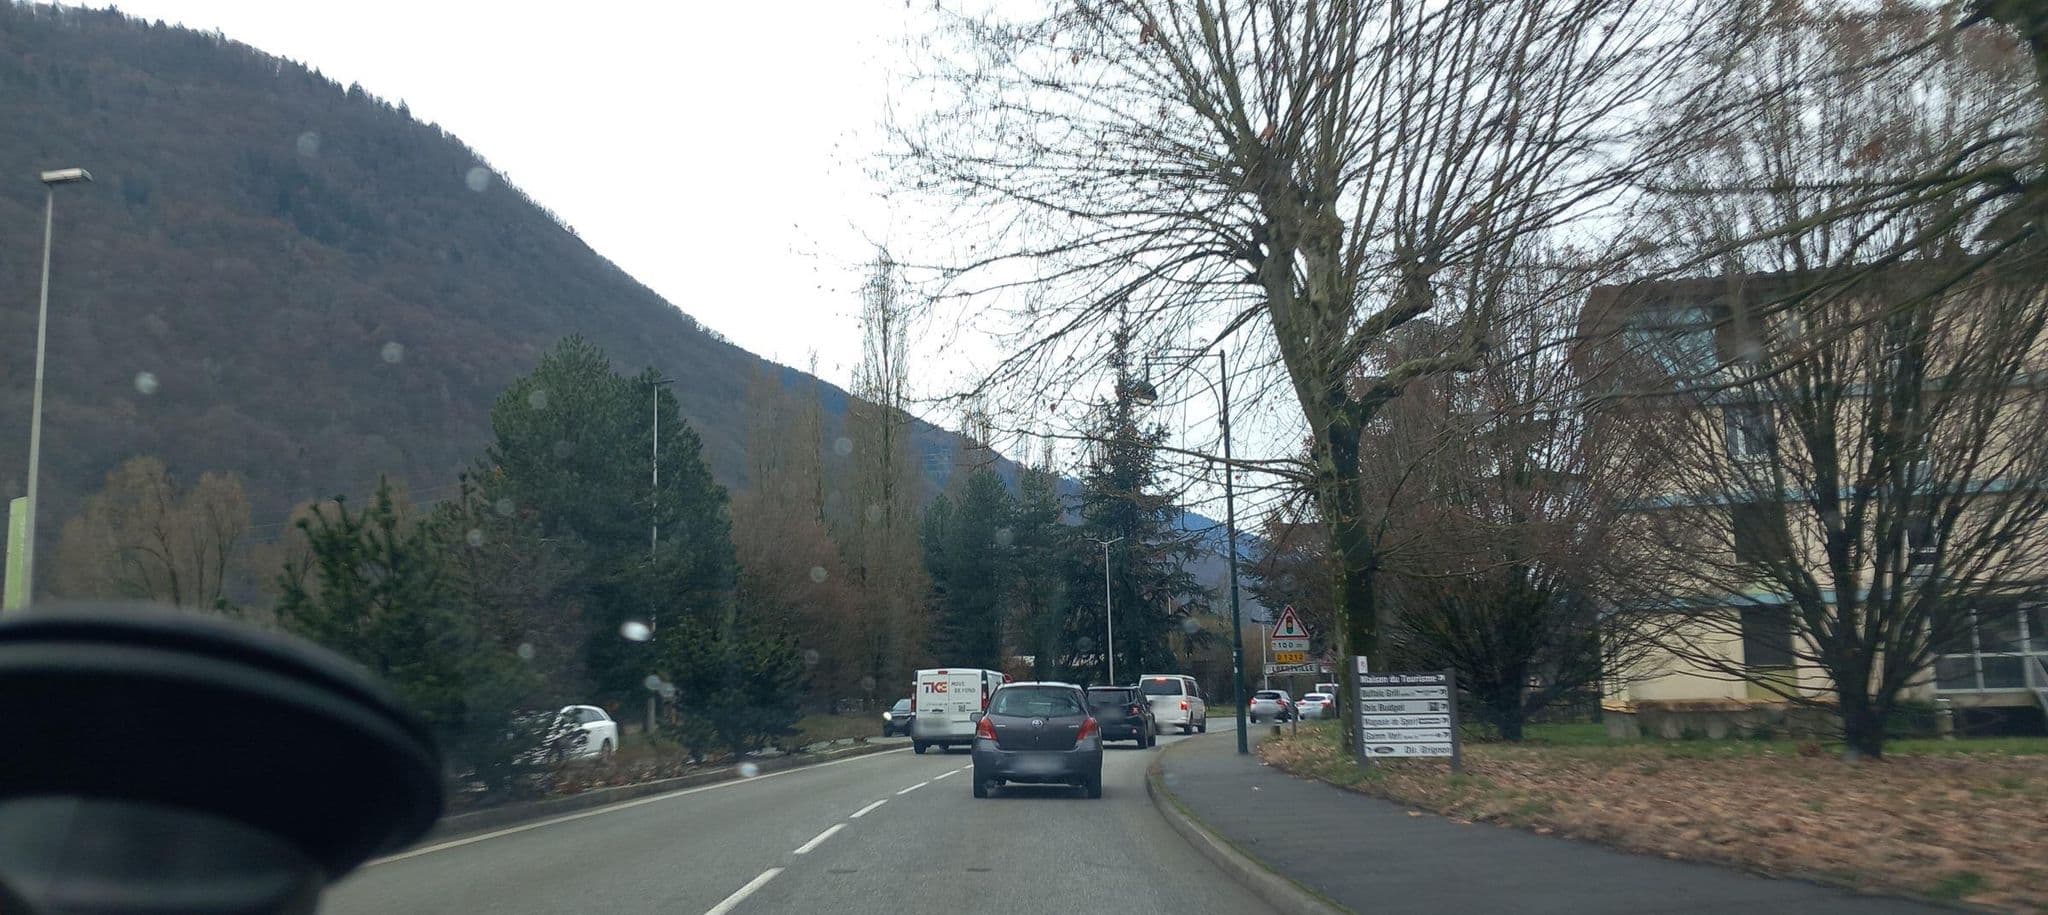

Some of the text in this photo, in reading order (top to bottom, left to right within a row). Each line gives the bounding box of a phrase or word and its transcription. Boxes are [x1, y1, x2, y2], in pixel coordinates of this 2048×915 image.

[1270, 665, 1314, 673] LBERTVILLE
[1360, 674, 1437, 683] Maison du Tourisme
[922, 681, 947, 694] TKE
